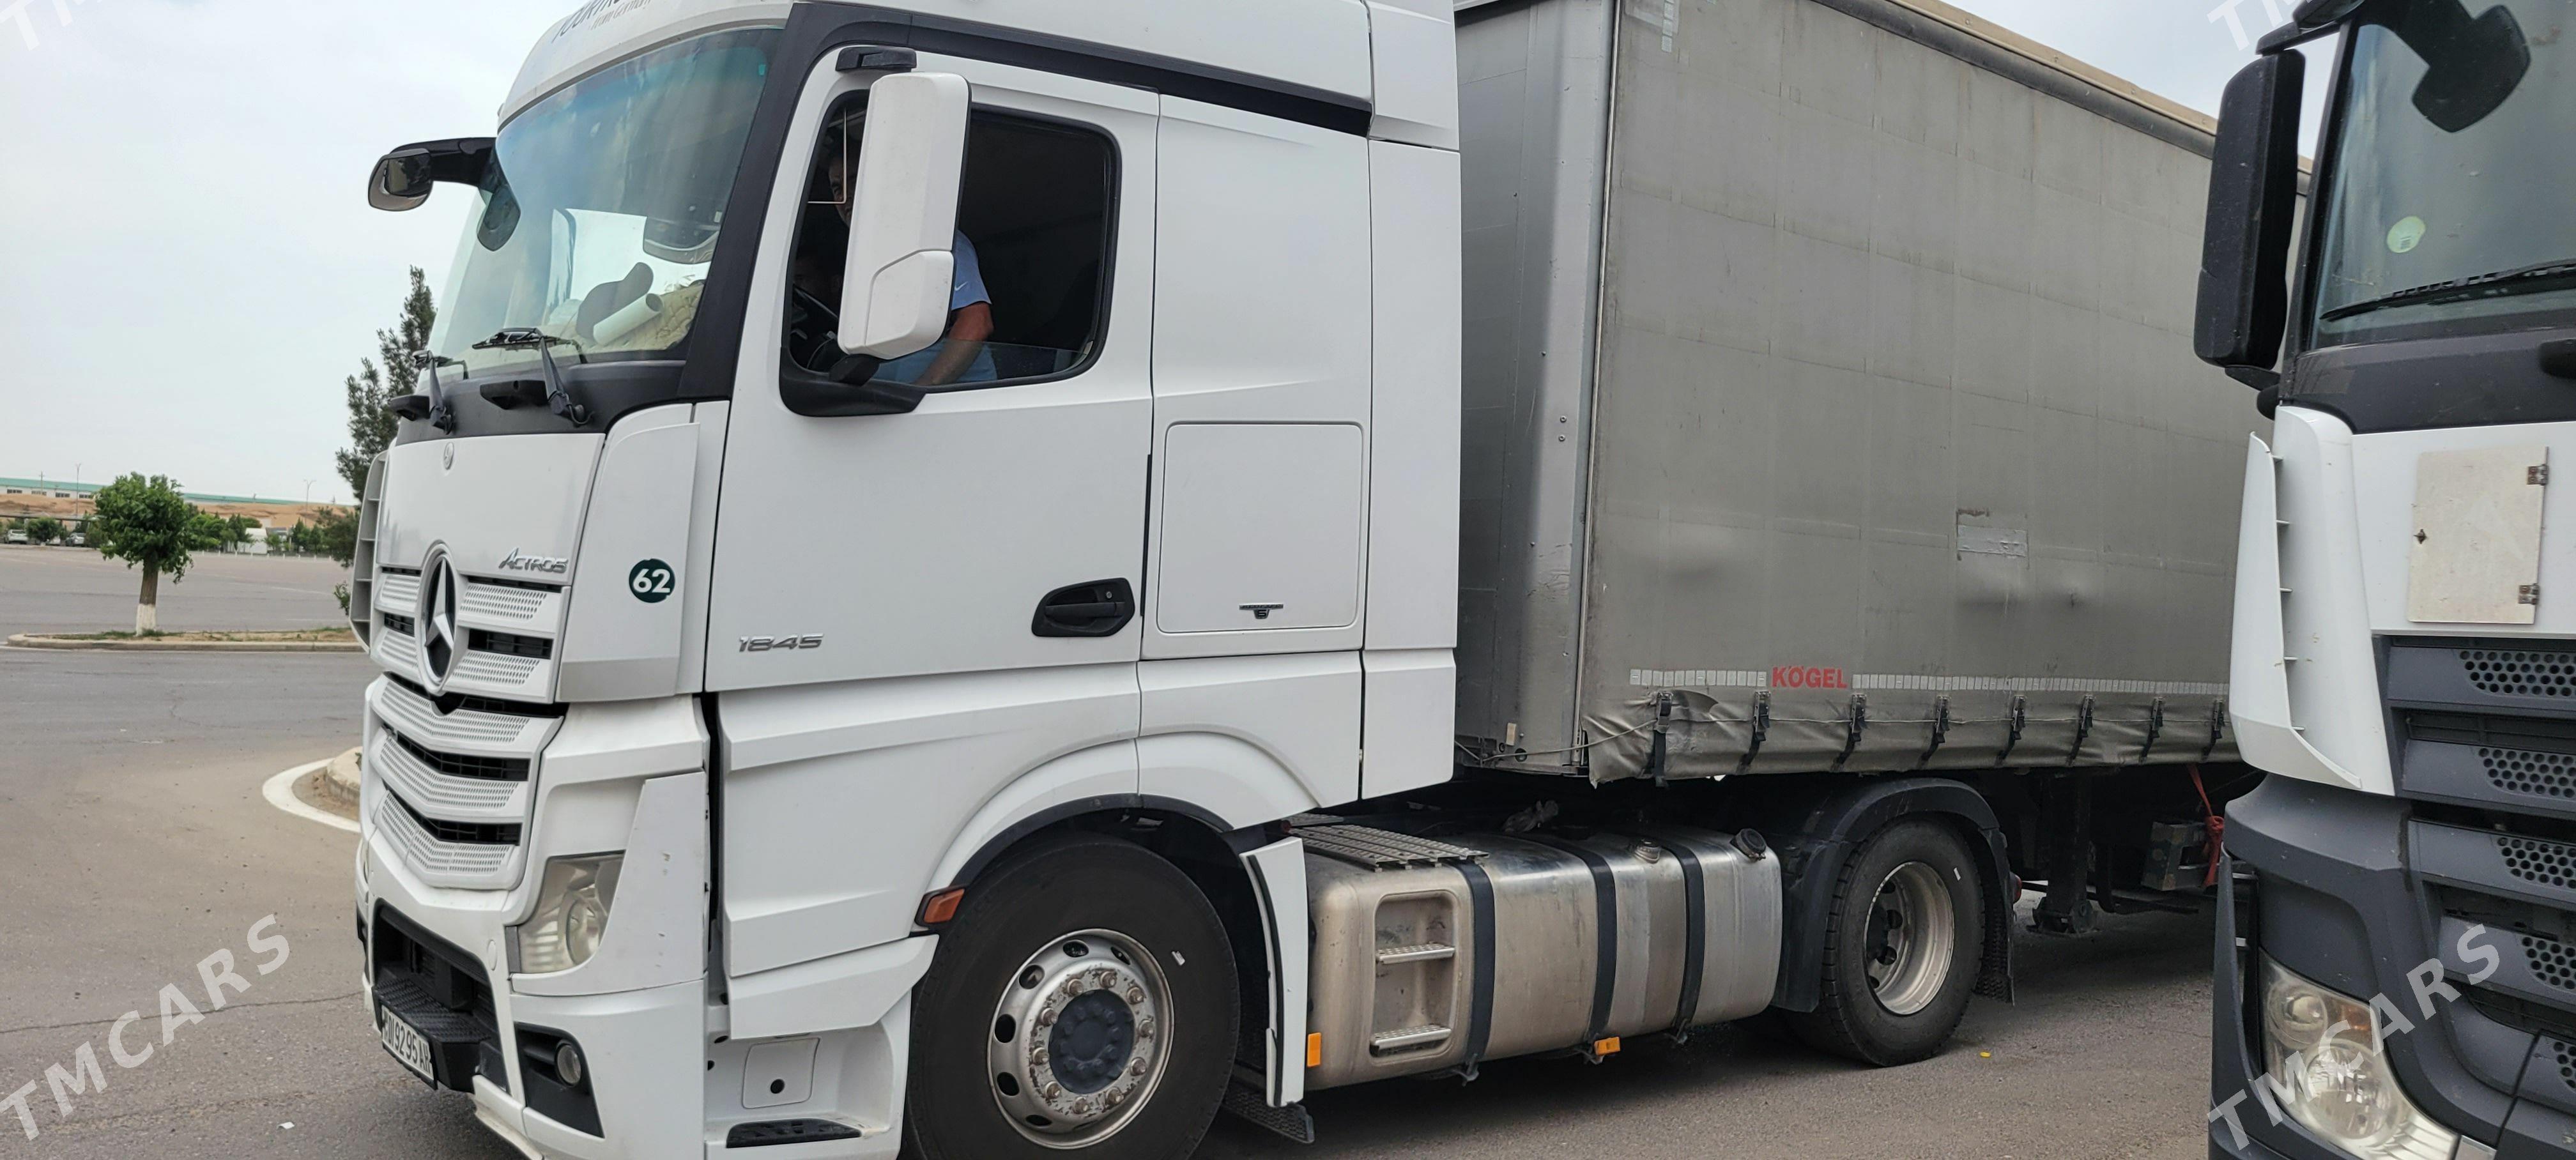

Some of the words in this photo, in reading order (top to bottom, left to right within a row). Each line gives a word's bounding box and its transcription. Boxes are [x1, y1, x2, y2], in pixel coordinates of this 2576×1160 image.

[632, 569, 671, 593] 62
[739, 633, 823, 652] 1845
[1772, 665, 1848, 689] KÖGEL
